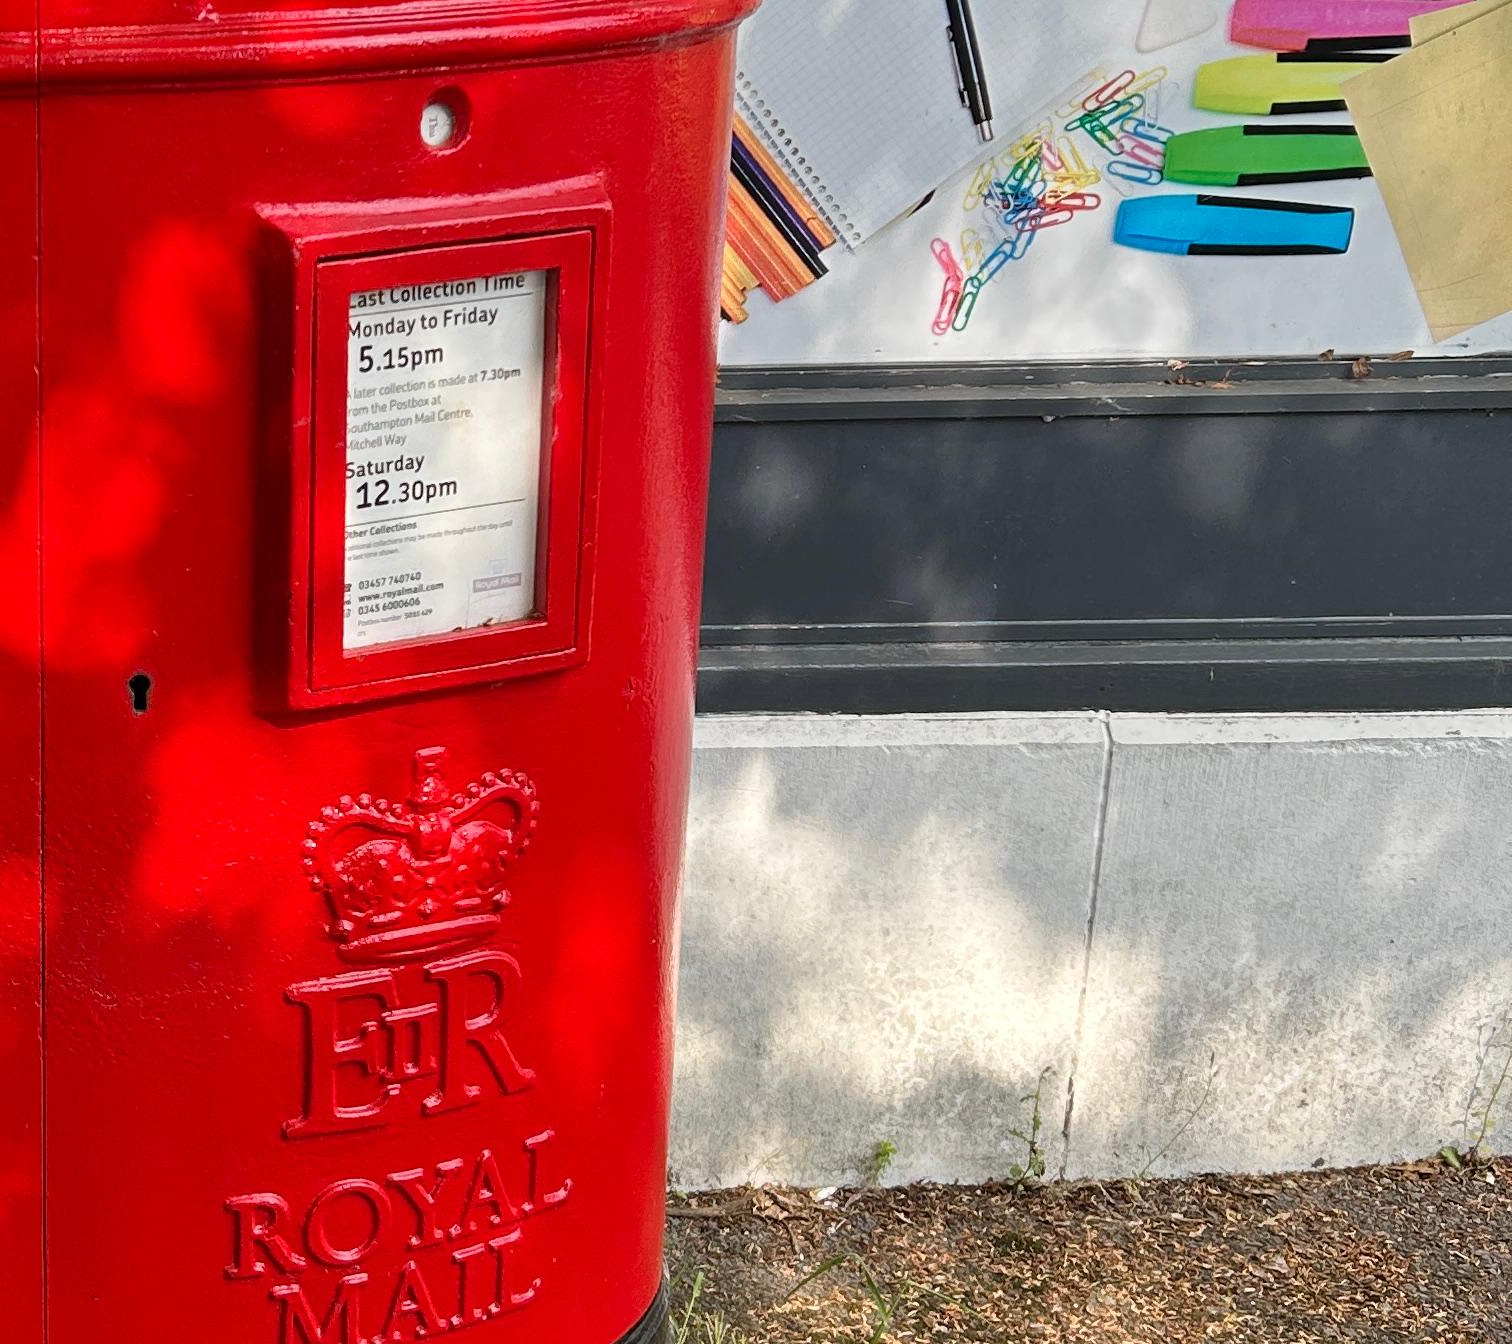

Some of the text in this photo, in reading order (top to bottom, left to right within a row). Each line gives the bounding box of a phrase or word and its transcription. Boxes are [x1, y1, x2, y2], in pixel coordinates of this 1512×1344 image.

[390, 281, 476, 304] Collection
[349, 307, 498, 339] Monday to Friday
[359, 345, 444, 373] 5.15pm
[354, 387, 377, 399] later
[378, 381, 426, 397] collection
[428, 380, 436, 390] is
[438, 374, 466, 388] made
[468, 373, 478, 384] at
[480, 367, 521, 382] 7.30pm
[348, 395, 442, 417] rom the Postbox at
[414, 411, 435, 424] Mail
[384, 433, 407, 446] Way
[346, 455, 425, 479] Saturday
[356, 480, 458, 509] 12.30pm
[370, 522, 417, 536] Collections
[358, 571, 422, 590] 03457 740740
[358, 582, 444, 602] www.royalmail.com
[358, 597, 421, 616] 0345 6000606
[223, 1129, 573, 1278] ROYAL
